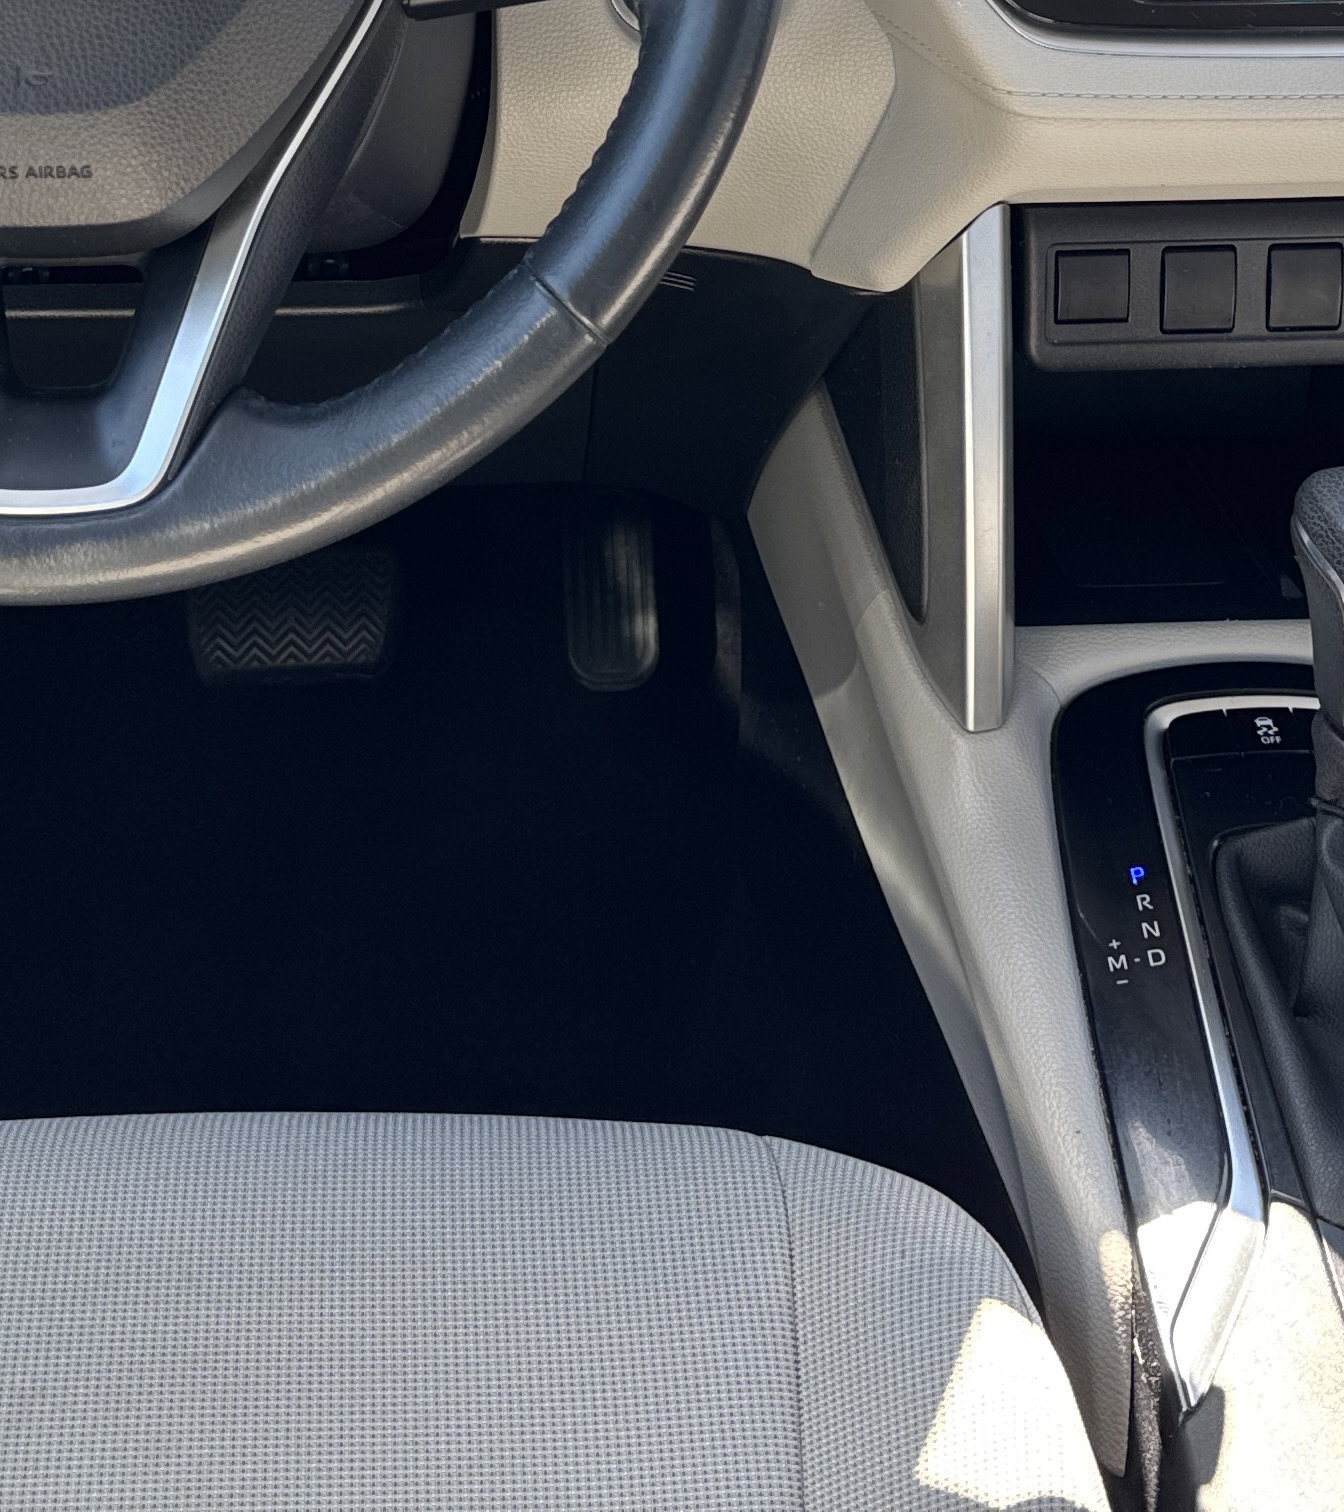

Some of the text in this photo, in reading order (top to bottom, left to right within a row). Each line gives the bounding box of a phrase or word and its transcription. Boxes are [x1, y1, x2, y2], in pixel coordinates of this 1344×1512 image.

[24, 164, 93, 179] AIRBAG
[1129, 866, 1145, 886] P
[1136, 893, 1154, 912] R
[1141, 920, 1161, 940] N
[1107, 948, 1167, 973] M D
